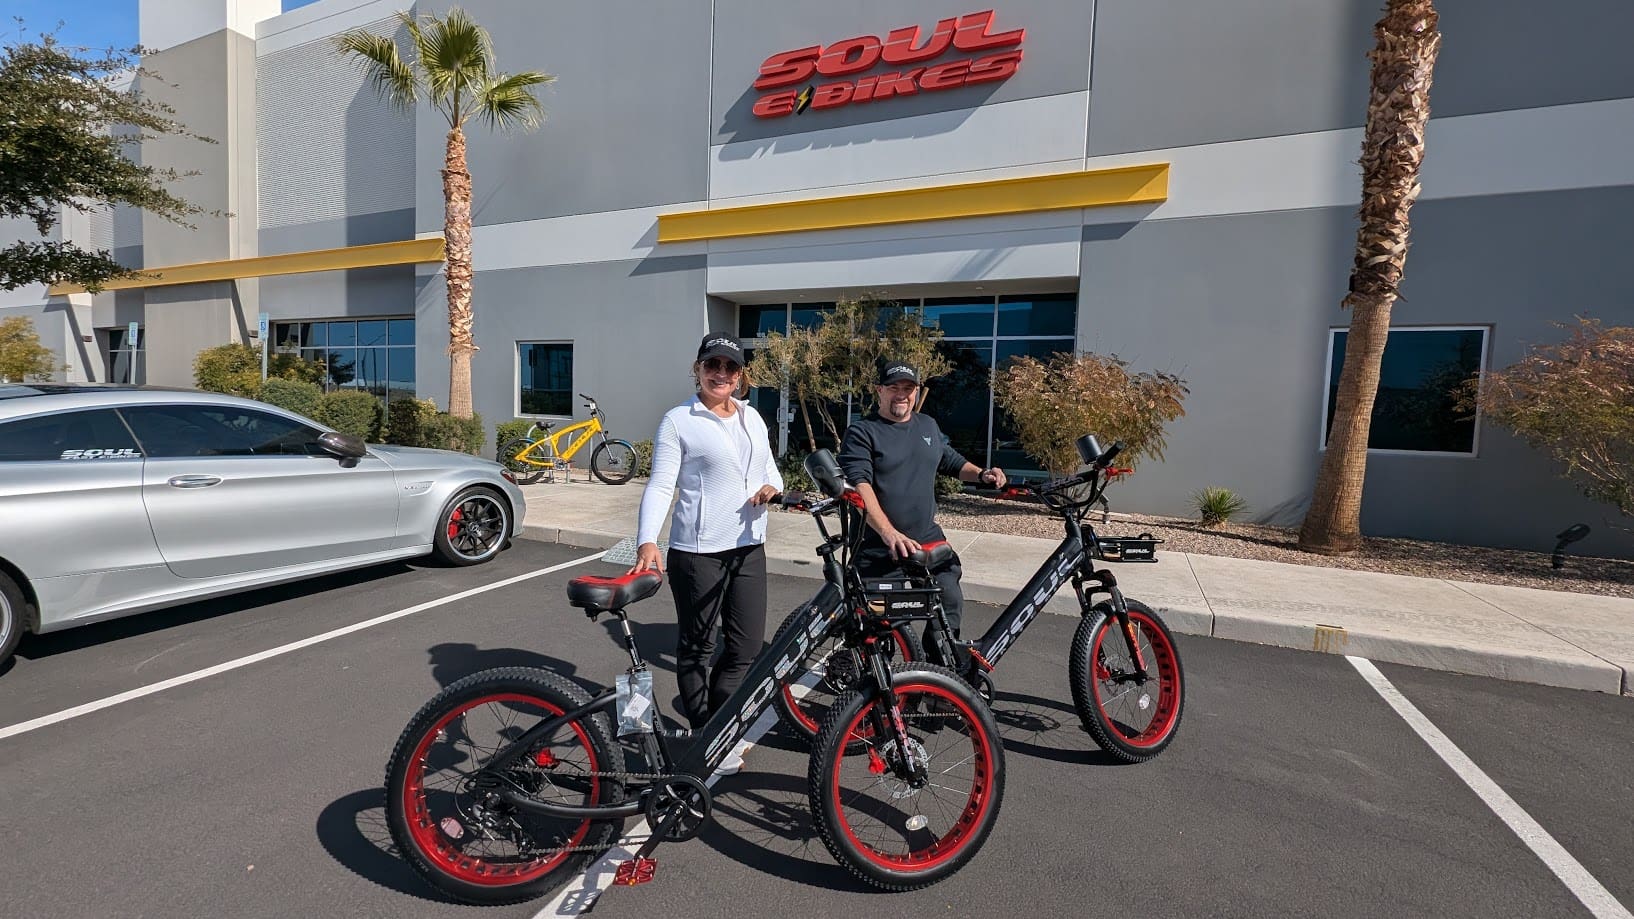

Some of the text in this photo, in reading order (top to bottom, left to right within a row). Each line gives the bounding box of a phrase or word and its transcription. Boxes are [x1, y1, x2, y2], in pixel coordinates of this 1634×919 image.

[753, 9, 1025, 91] SOUL
[61, 448, 142, 457] SOUL
[985, 551, 1083, 665] SOUL
[704, 602, 844, 768] SOUL
